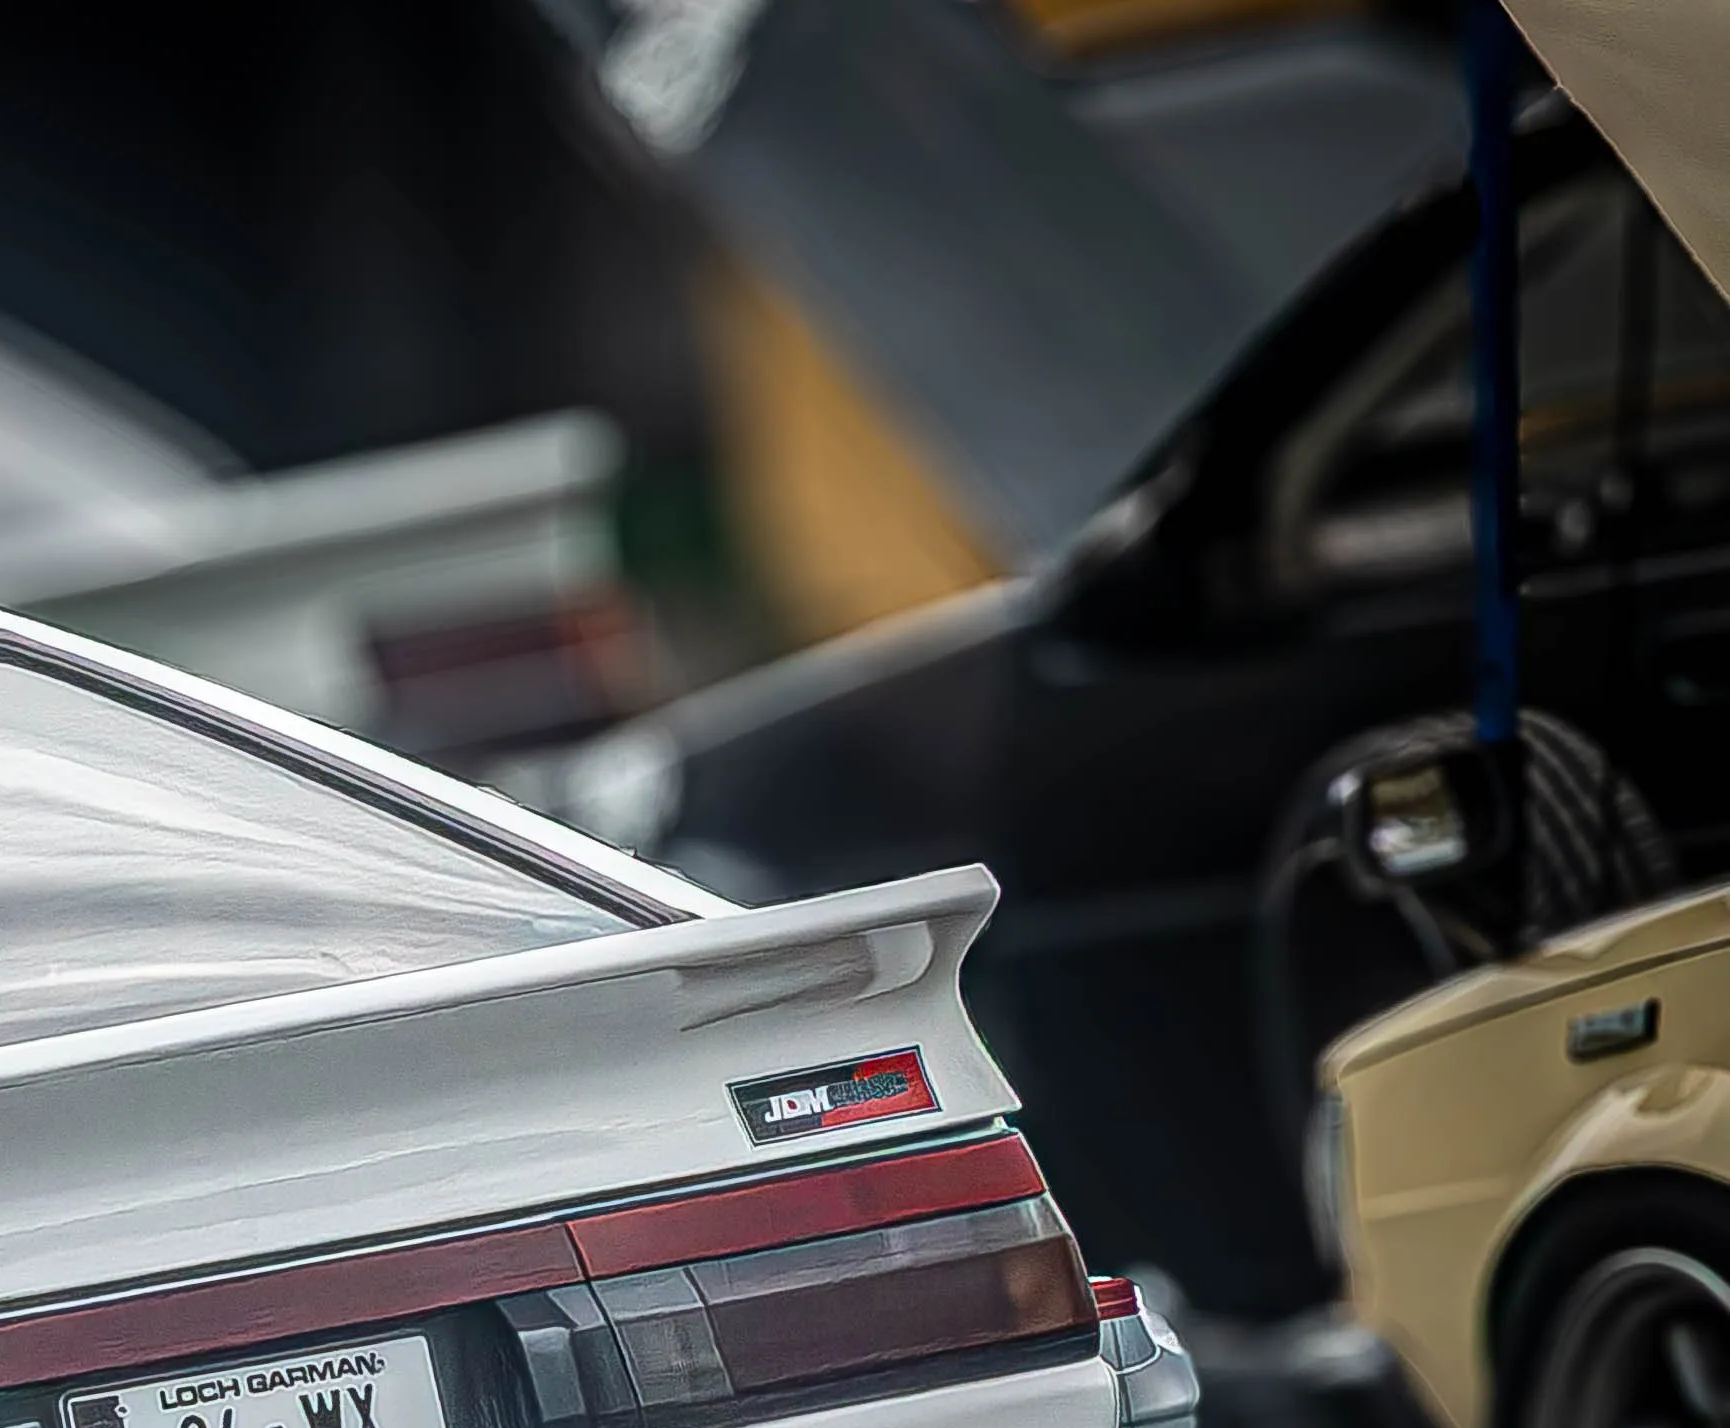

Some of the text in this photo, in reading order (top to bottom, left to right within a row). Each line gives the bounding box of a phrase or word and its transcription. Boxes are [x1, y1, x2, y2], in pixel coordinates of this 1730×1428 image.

[764, 1085, 832, 1124] JDM
[159, 1352, 386, 1410] LOCH GARMAN
